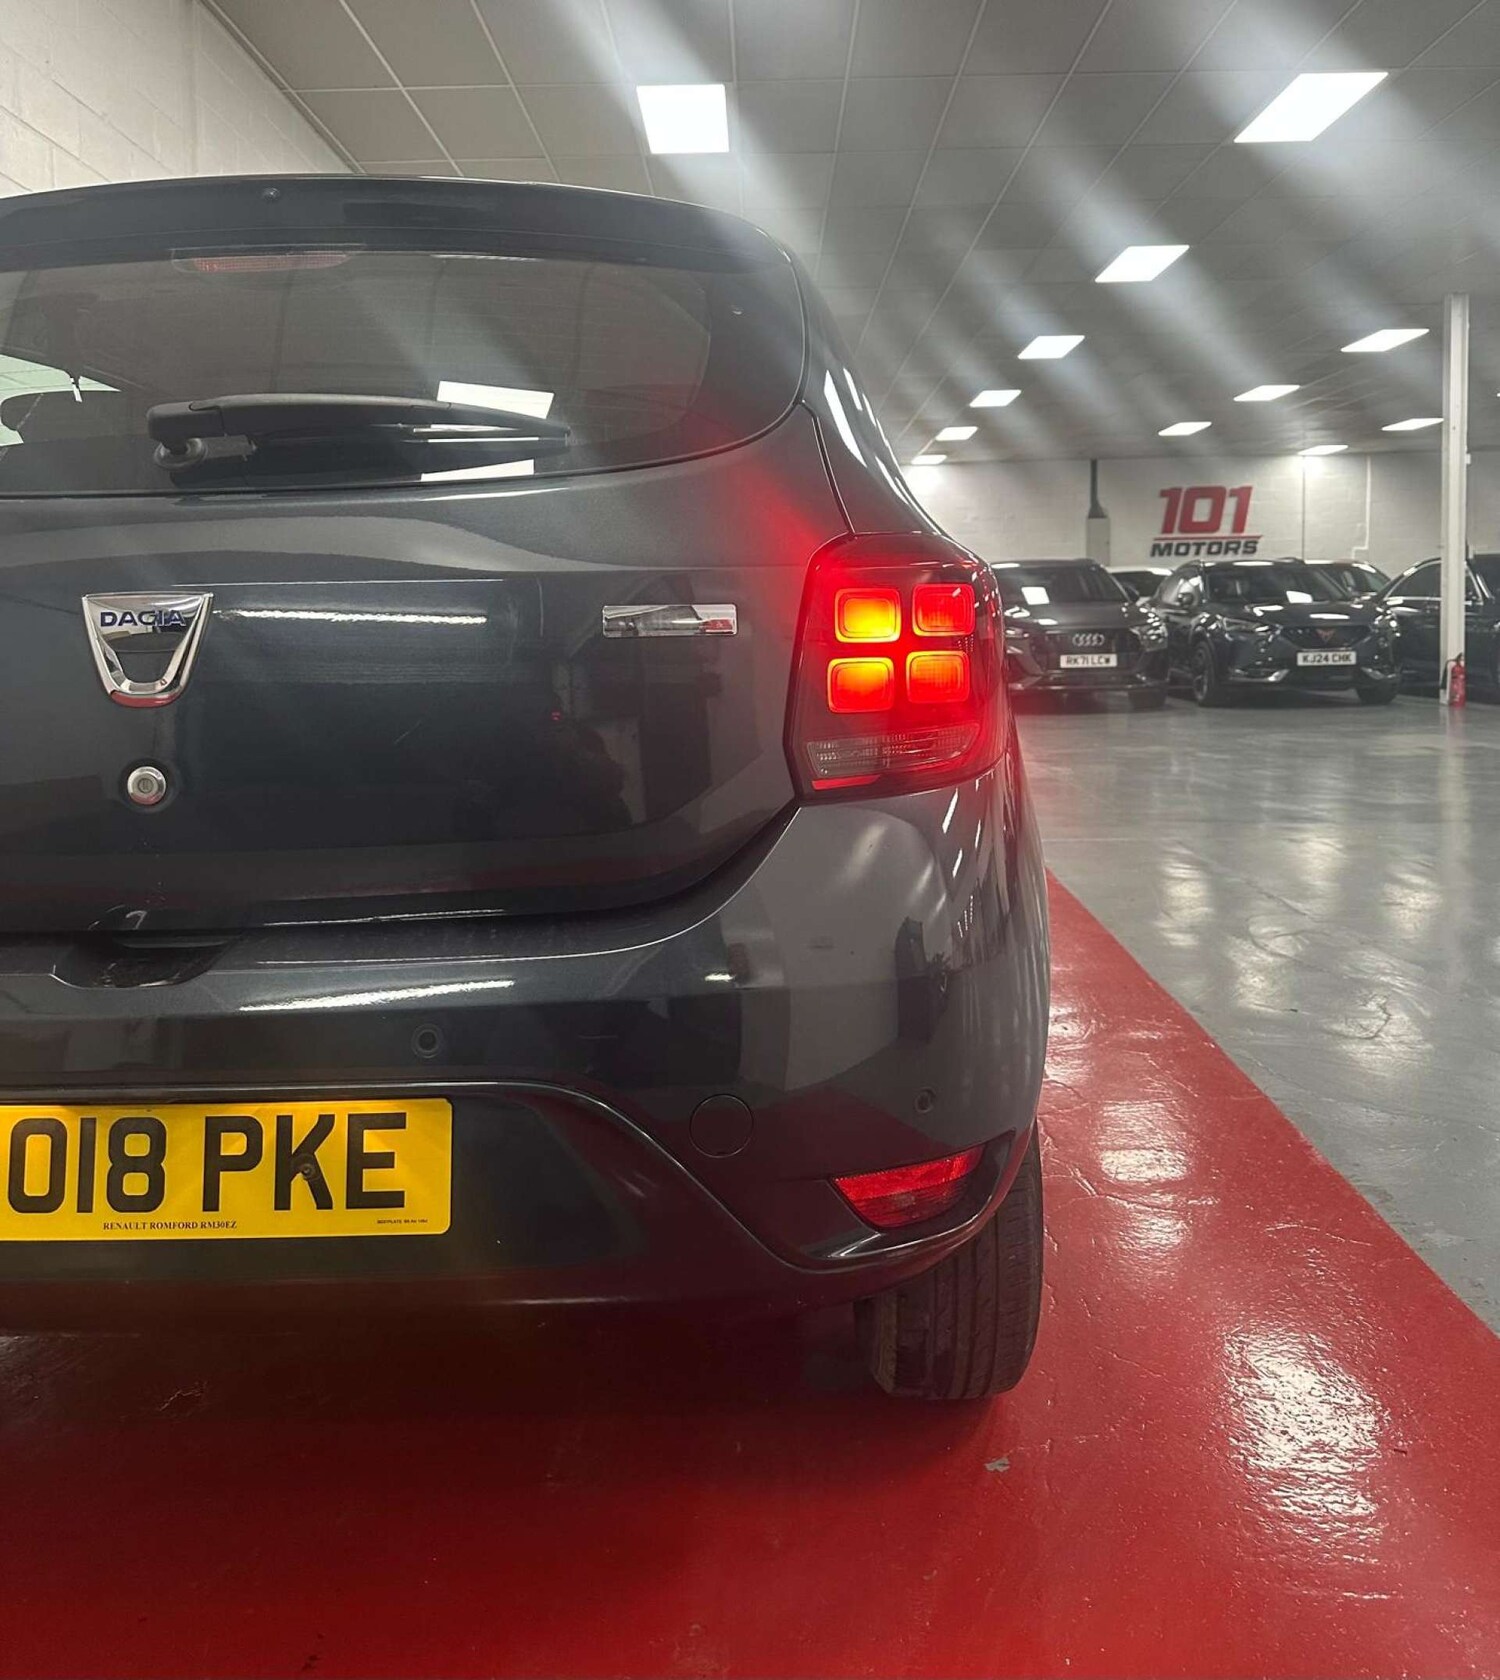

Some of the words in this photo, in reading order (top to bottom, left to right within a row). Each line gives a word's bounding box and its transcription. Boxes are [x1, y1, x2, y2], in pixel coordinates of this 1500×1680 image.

[1159, 486, 1253, 534] 101
[1150, 541, 1258, 557] MOTORS
[100, 610, 186, 627] DACIA
[1302, 654, 1329, 663] KJ24
[202, 1112, 407, 1213] PKE
[103, 1222, 147, 1230] RENAULT
[149, 1221, 198, 1229] ROMFORD
